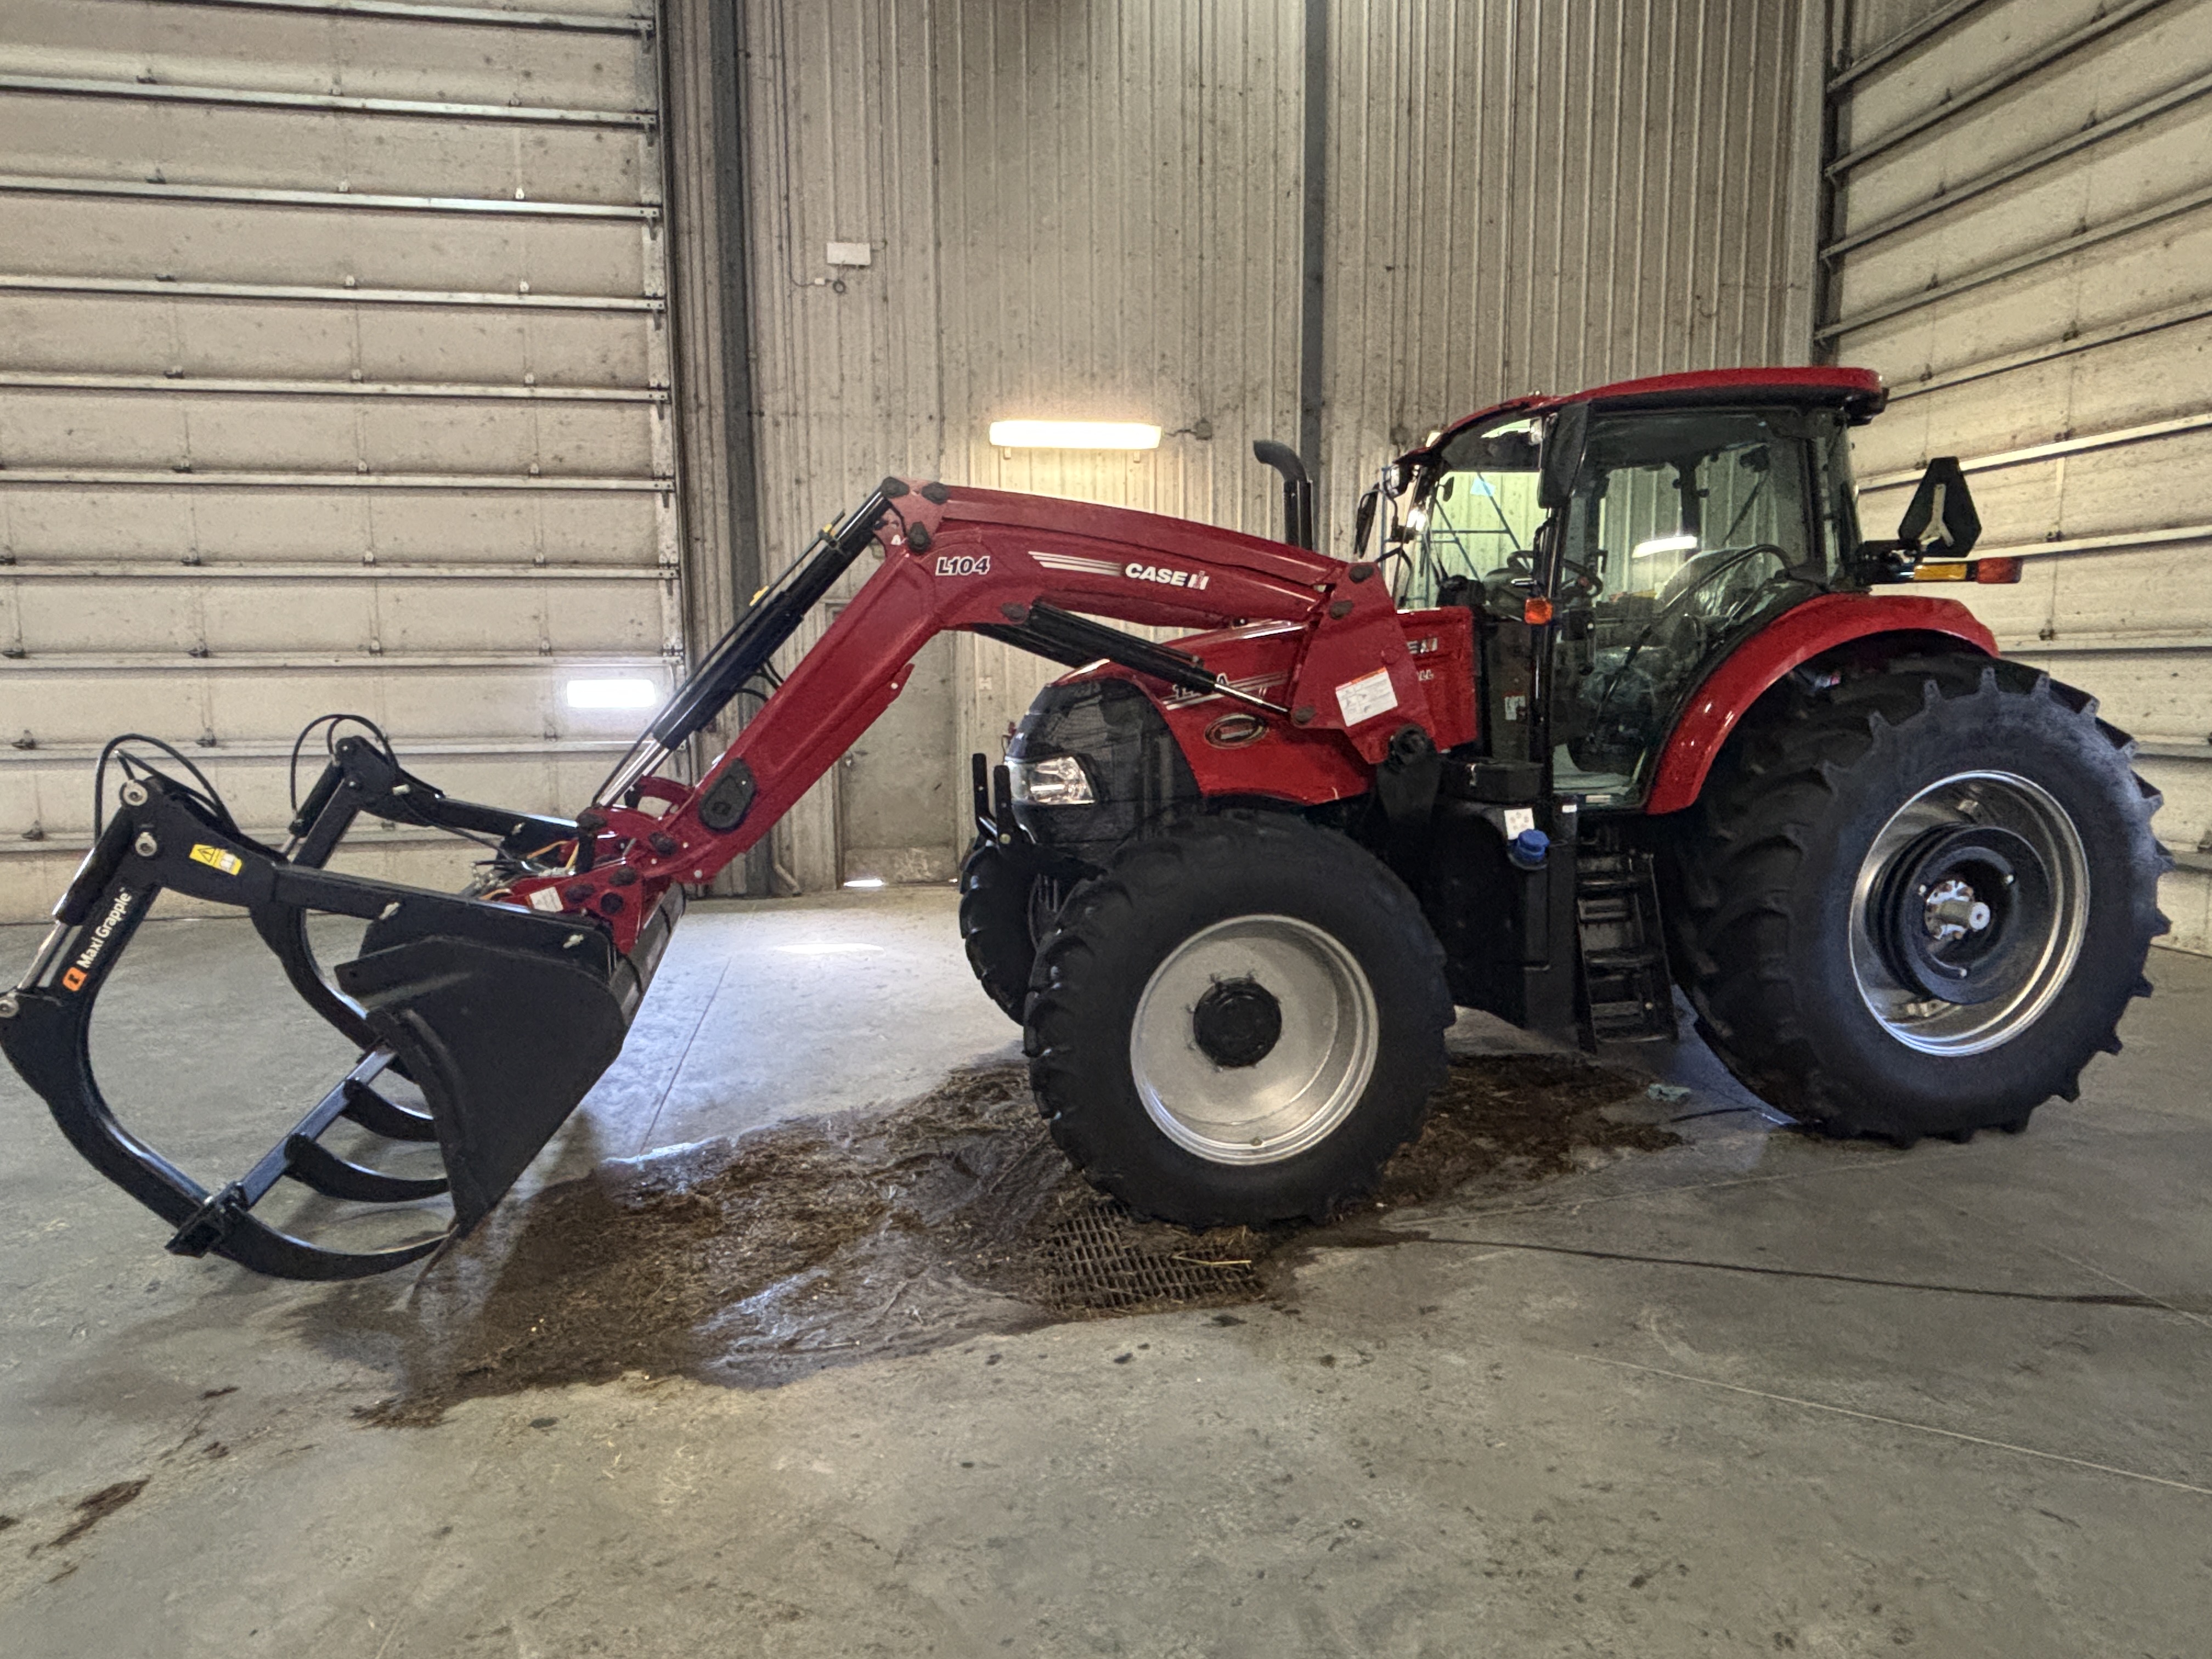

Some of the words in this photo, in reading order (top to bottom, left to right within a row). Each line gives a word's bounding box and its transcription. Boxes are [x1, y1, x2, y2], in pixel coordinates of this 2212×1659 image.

[935, 556, 990, 576] L104
[1125, 563, 1188, 586] CASE
[76, 936, 105, 969] Maxi
